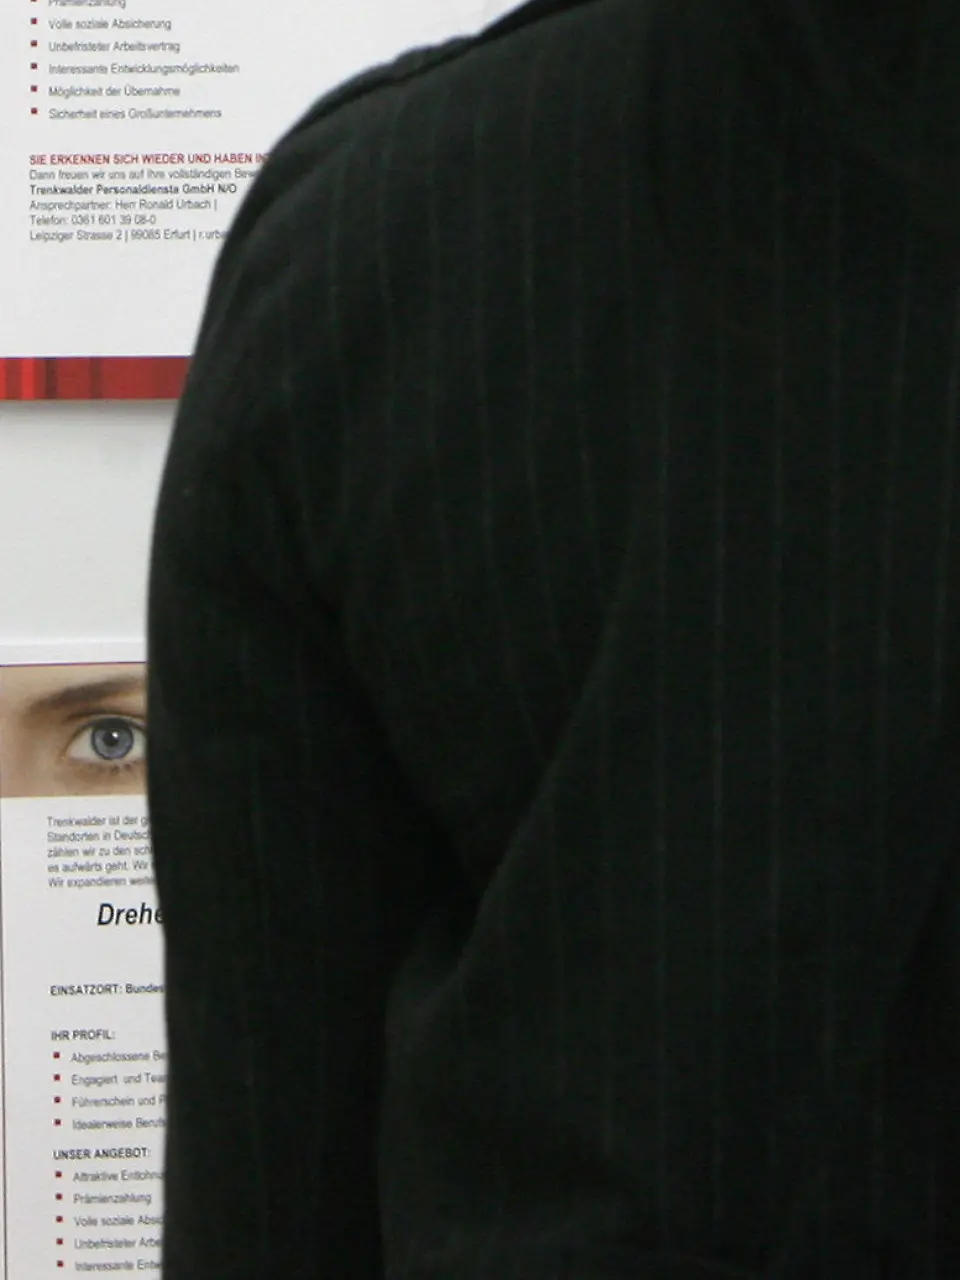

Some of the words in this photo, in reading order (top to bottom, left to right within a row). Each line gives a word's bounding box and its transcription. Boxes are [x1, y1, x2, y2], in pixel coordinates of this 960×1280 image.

[29, 154, 46, 165] SIE
[50, 154, 110, 164] ERKENNEN
[113, 154, 138, 164] SICH
[141, 153, 184, 164] WIEDER
[188, 153, 210, 164] UND
[214, 153, 252, 163] HABEN
[30, 184, 94, 195] Trenkwalder
[182, 183, 215, 193] GmbH
[50, 984, 123, 996] EINSATZORT:
[50, 1030, 70, 1041] IHR
[72, 1029, 116, 1040] PROFIL:
[52, 1149, 90, 1160] UNSER
[94, 1148, 152, 1159] ANGEBOT:
